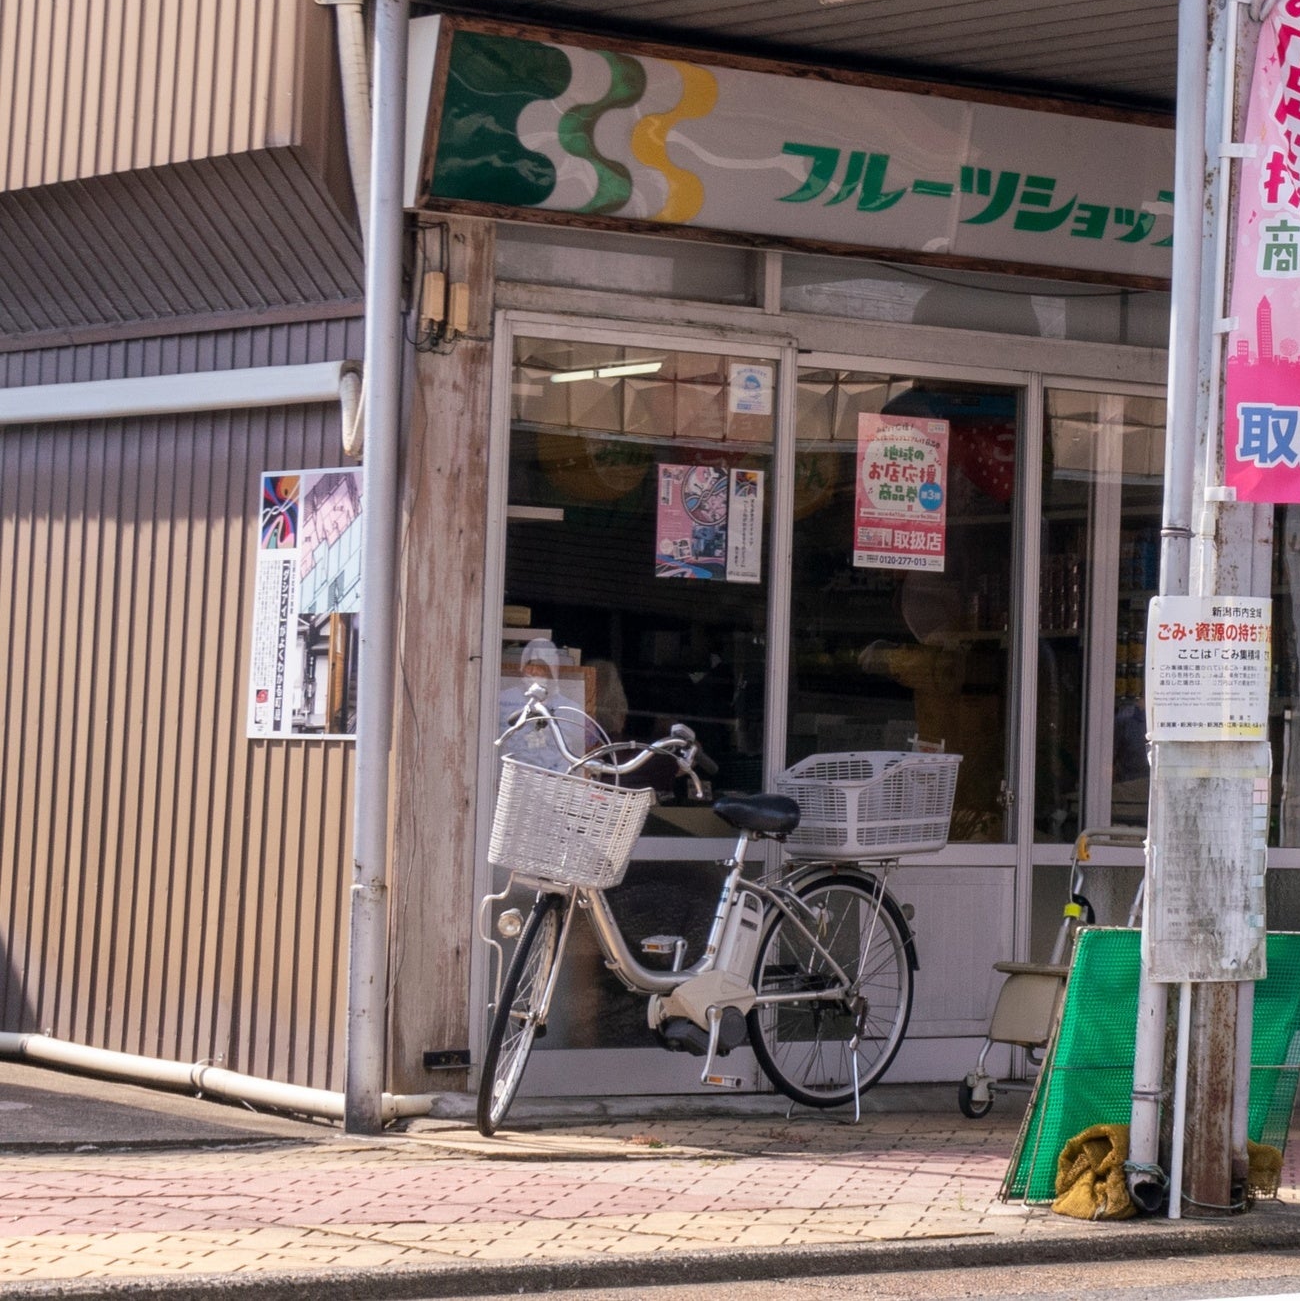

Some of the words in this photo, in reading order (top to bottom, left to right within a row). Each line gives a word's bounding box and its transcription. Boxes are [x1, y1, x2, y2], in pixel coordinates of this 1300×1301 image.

[883, 445, 925, 462] 地域の
[868, 462, 937, 483] お店応援
[879, 483, 918, 503] 商品券
[893, 530, 942, 551] 取扱店
[879, 555, 927, 567] 0120-277-013
